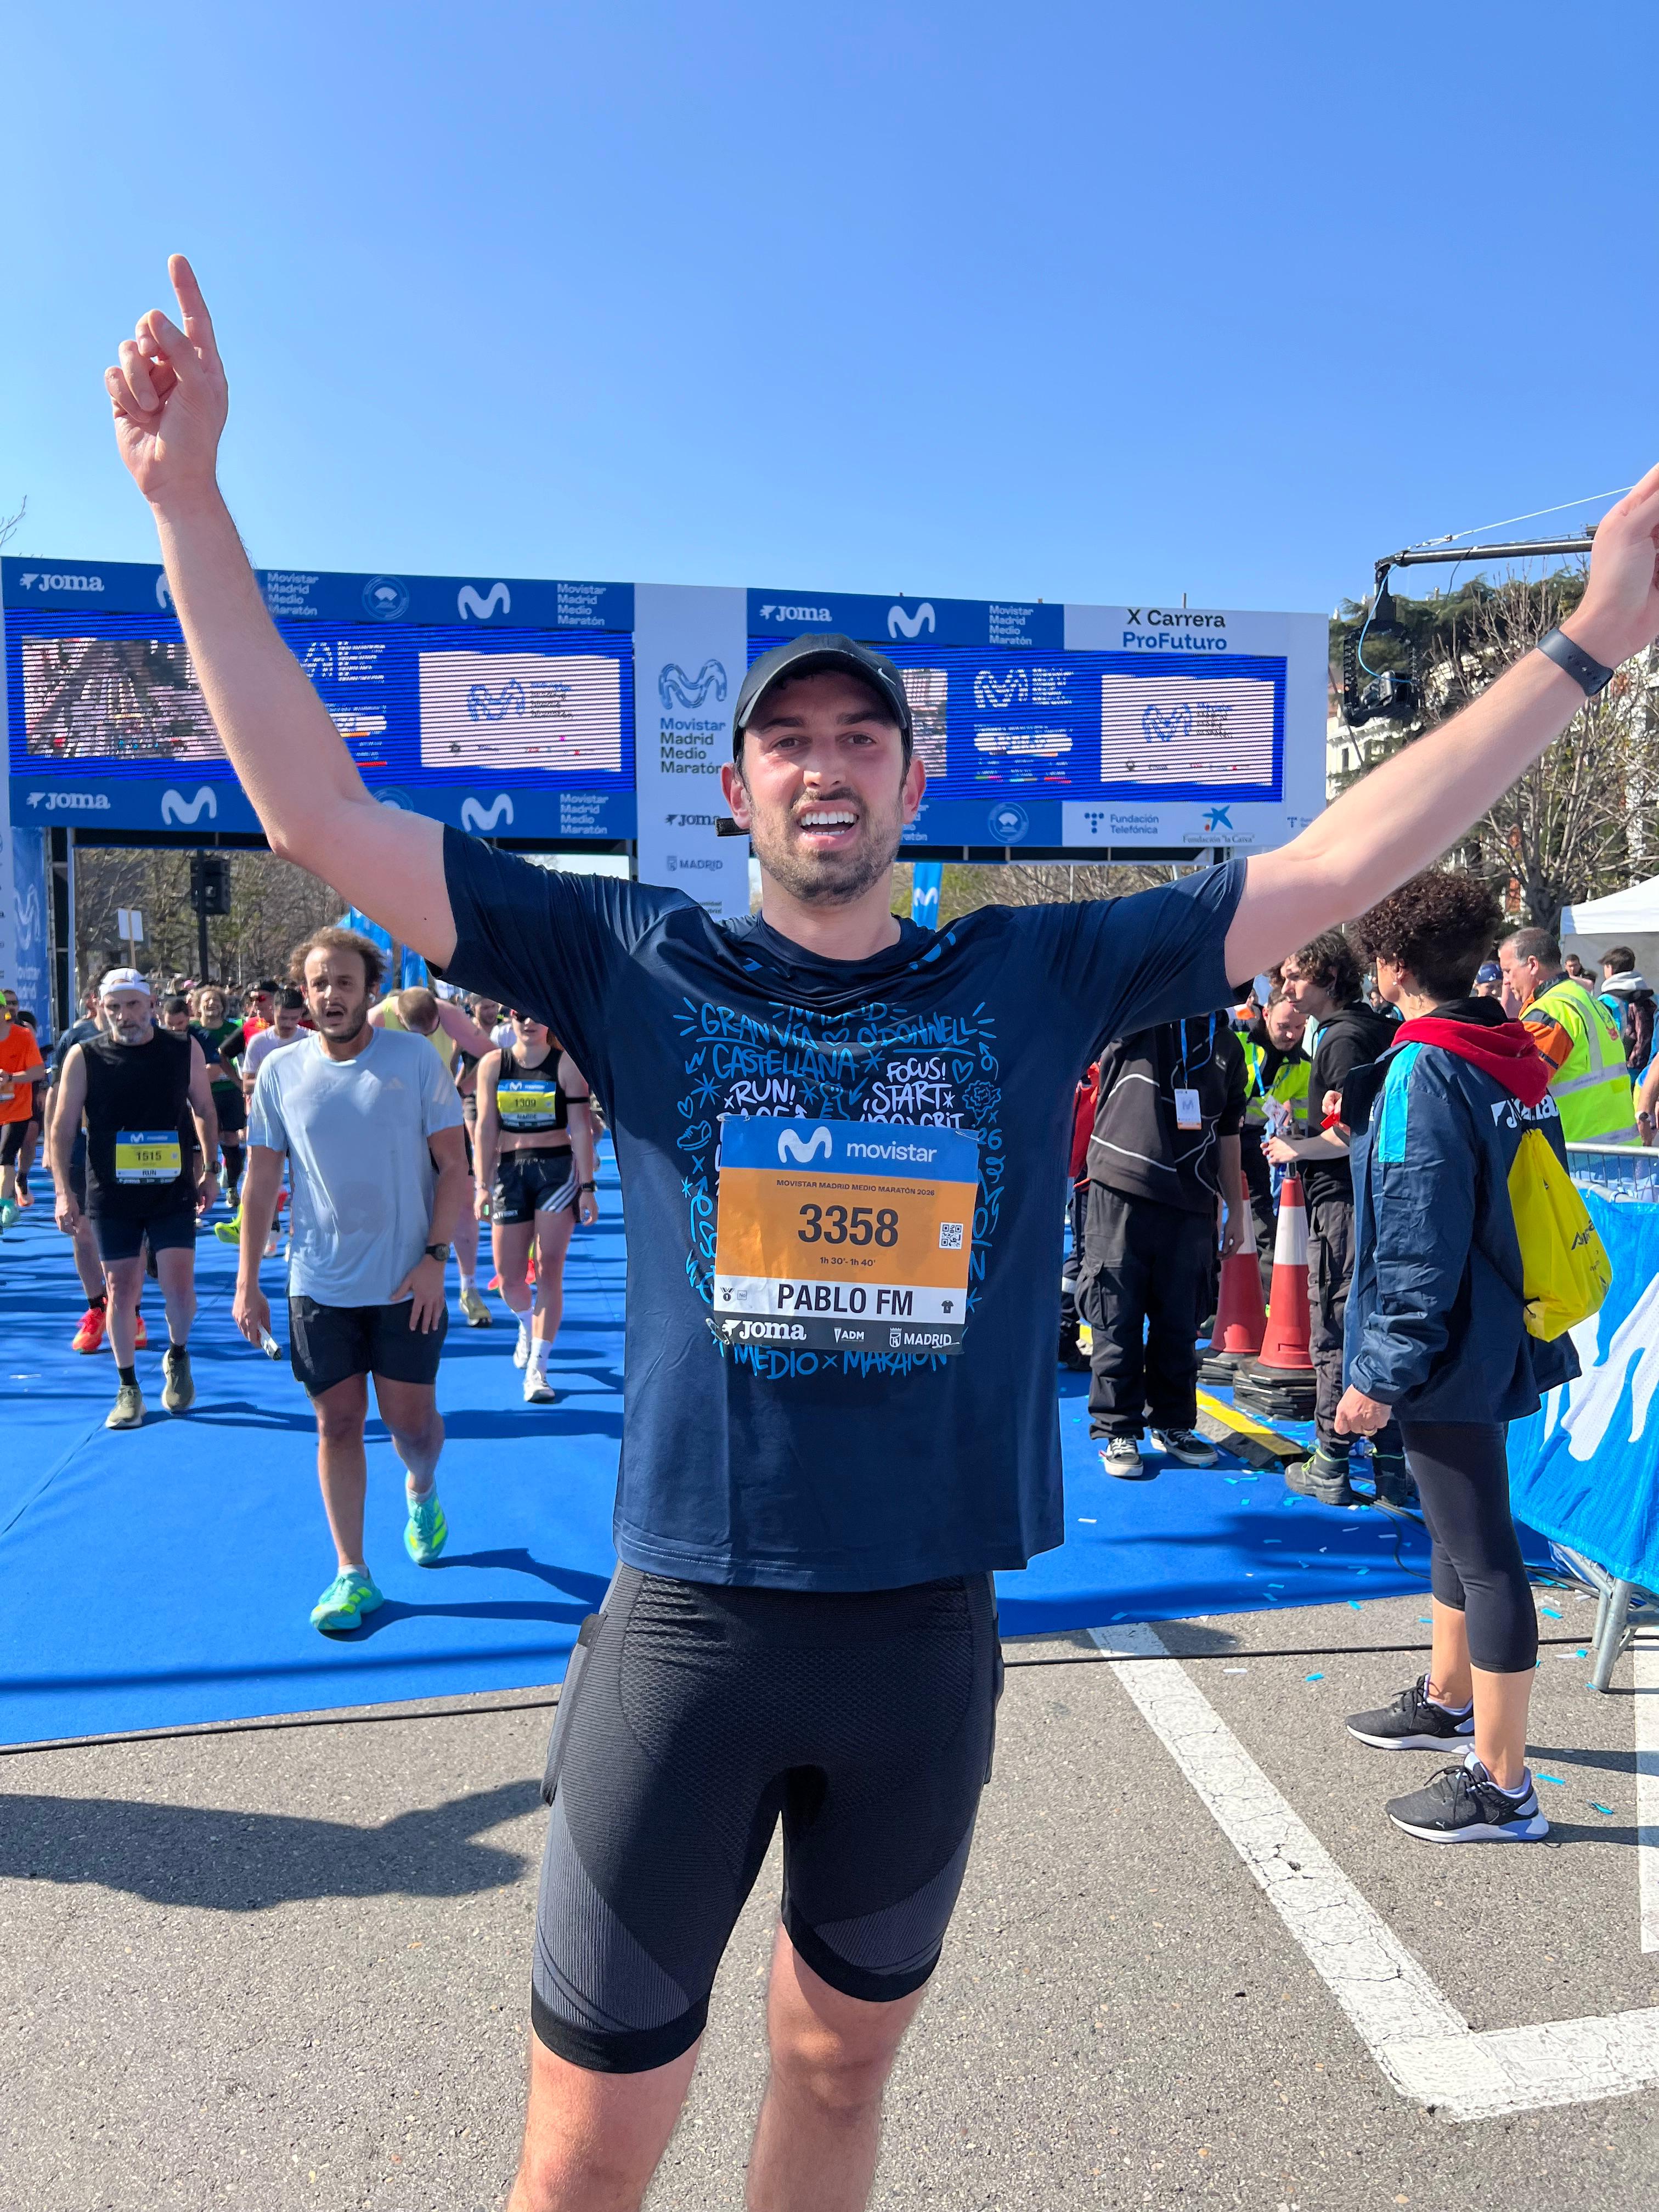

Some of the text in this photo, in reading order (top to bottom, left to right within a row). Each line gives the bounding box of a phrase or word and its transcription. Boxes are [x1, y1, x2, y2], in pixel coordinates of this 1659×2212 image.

[1127, 609, 1226, 628] X Carrera
[1123, 631, 1227, 651] ProFuturo
[660, 718, 726, 731] Movistar
[661, 732, 714, 745] Madrid
[661, 747, 707, 759] Medio
[1110, 814, 1159, 823] Fundación
[1110, 825, 1158, 834] Telefónica
[680, 860, 723, 869] MADRID
[701, 1003, 770, 1045] GRAN
[713, 1043, 860, 1081] CASTELLANA
[886, 1057, 946, 1083] FOCUS!
[730, 1078, 795, 1107] RUN!
[871, 1081, 952, 1114] START
[847, 1141, 938, 1163] movistar
[776, 1180, 817, 1188] MOVISTAR
[819, 1182, 850, 1190] MADRID
[878, 1185, 916, 1195] MARATÓN
[798, 1203, 899, 1248] 3358
[778, 1284, 867, 1314] PABLO
[876, 1289, 913, 1316] FM
[841, 1330, 865, 1340] ADM
[904, 1333, 952, 1345] MADRID
